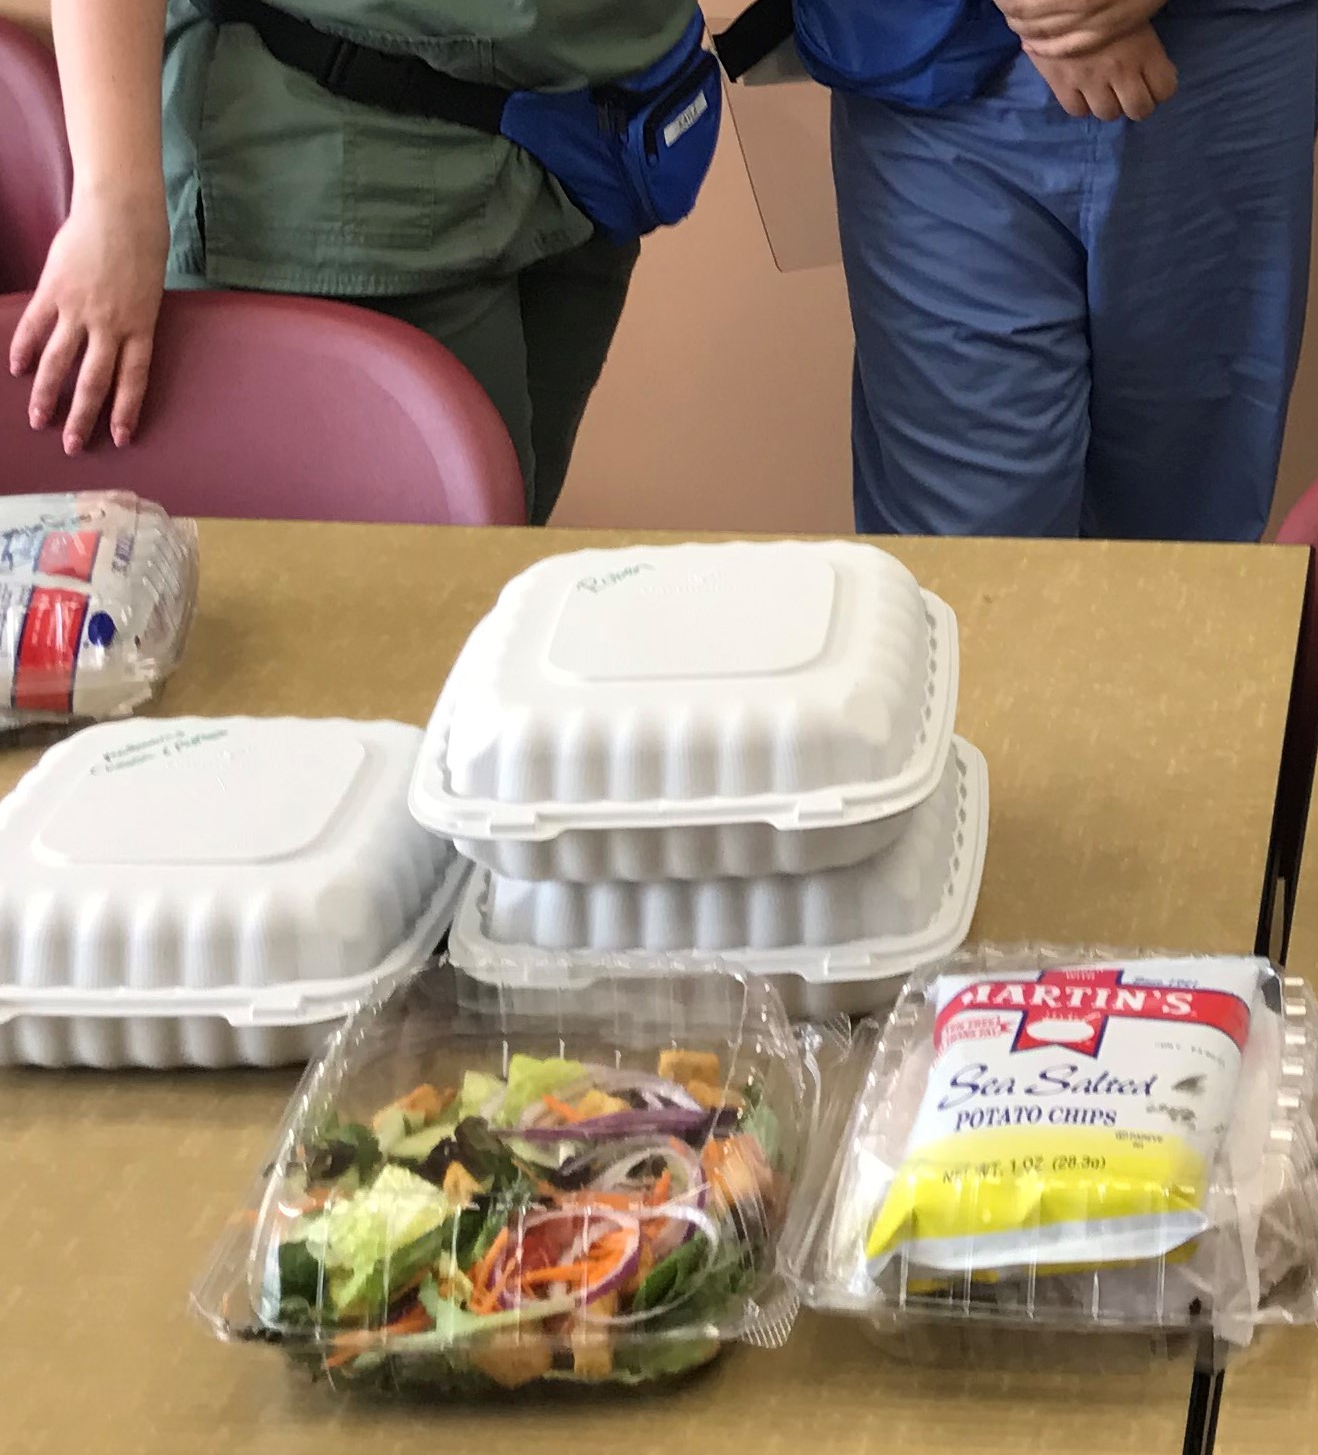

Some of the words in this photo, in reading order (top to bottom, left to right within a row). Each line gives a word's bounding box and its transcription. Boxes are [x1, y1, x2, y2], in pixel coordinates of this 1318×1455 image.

[961, 983, 1195, 1016] MARTIN'S
[937, 1063, 1015, 1110] Sea
[1024, 1063, 1158, 1097] Salted
[953, 1104, 1043, 1132] POTATO
[1048, 1106, 1118, 1127] CHIPS
[1010, 1157, 1017, 1173] 1
[1022, 1155, 1044, 1171] OZ
[1052, 1154, 1107, 1173] (28.3g)
